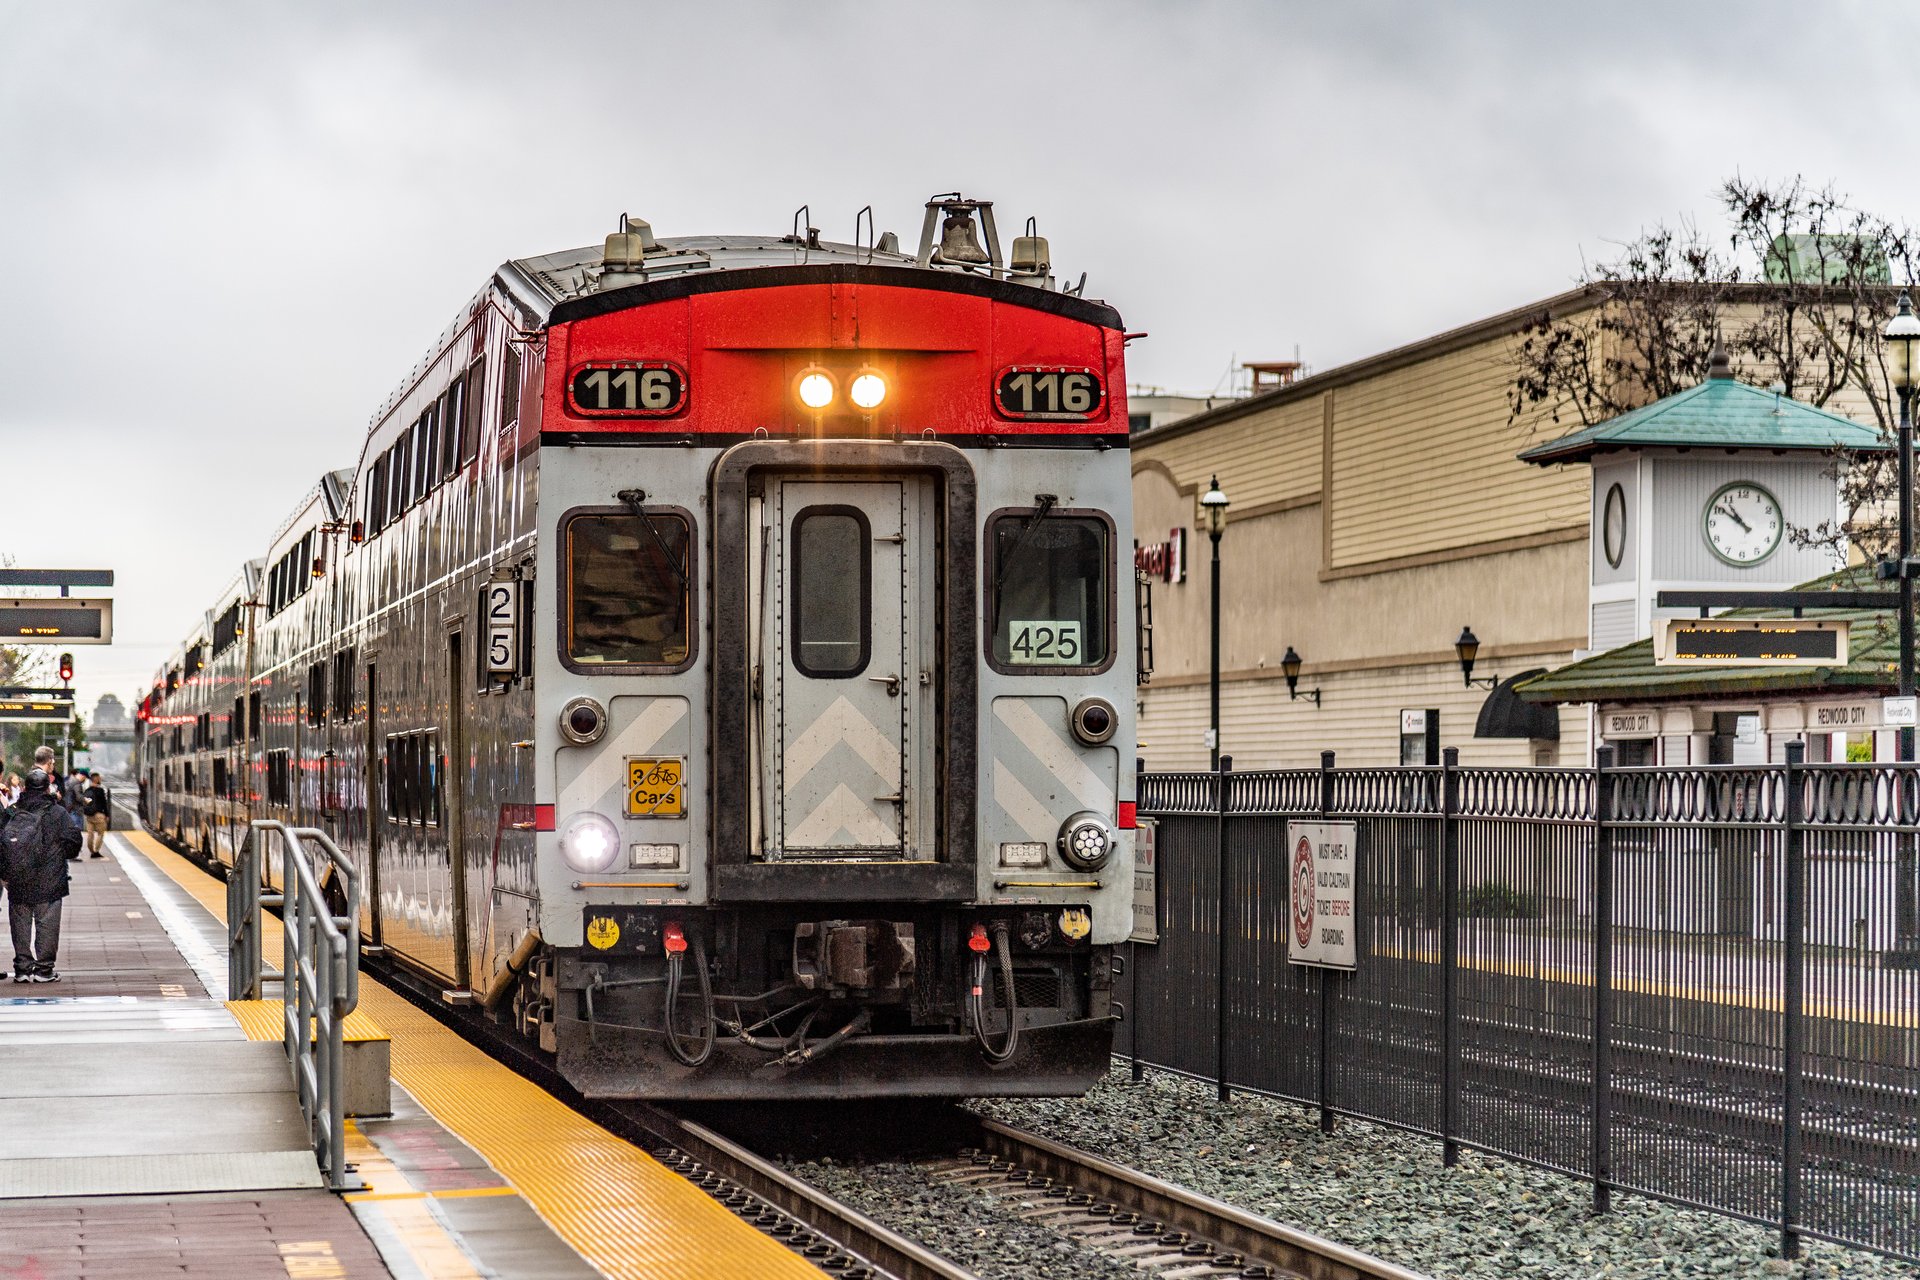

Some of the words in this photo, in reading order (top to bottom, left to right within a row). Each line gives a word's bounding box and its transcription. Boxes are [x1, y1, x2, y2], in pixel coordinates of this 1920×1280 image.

[583, 370, 672, 409] 116
[1009, 374, 1091, 412] 116
[1724, 495, 1733, 503] 11
[1738, 489, 1749, 498] 12
[1757, 495, 1761, 503] 1
[1765, 506, 1772, 515] 2
[1709, 520, 1716, 528] 9
[1769, 521, 1776, 529] 3
[1713, 535, 1720, 543] 8
[1725, 547, 1732, 555] 7
[1739, 551, 1745, 559] 6
[1754, 547, 1760, 555] 5
[1012, 627, 1078, 660] 425
[1612, 716, 1636, 731] REDWOOD
[1638, 714, 1649, 731] CITY
[1818, 706, 1848, 725] REDWOOD
[1851, 706, 1866, 723] CITY
[633, 769, 645, 785] 3
[635, 790, 676, 805] Cars
[1318, 843, 1330, 859] MUST
[1331, 844, 1343, 859] HAVE
[1343, 844, 1348, 860] A
[1317, 871, 1329, 888] VALID
[1329, 872, 1351, 888] CALTRAIN
[1317, 900, 1331, 916] TICKET
[1332, 900, 1350, 916] BEFORE
[1321, 928, 1344, 946] BOARDING
